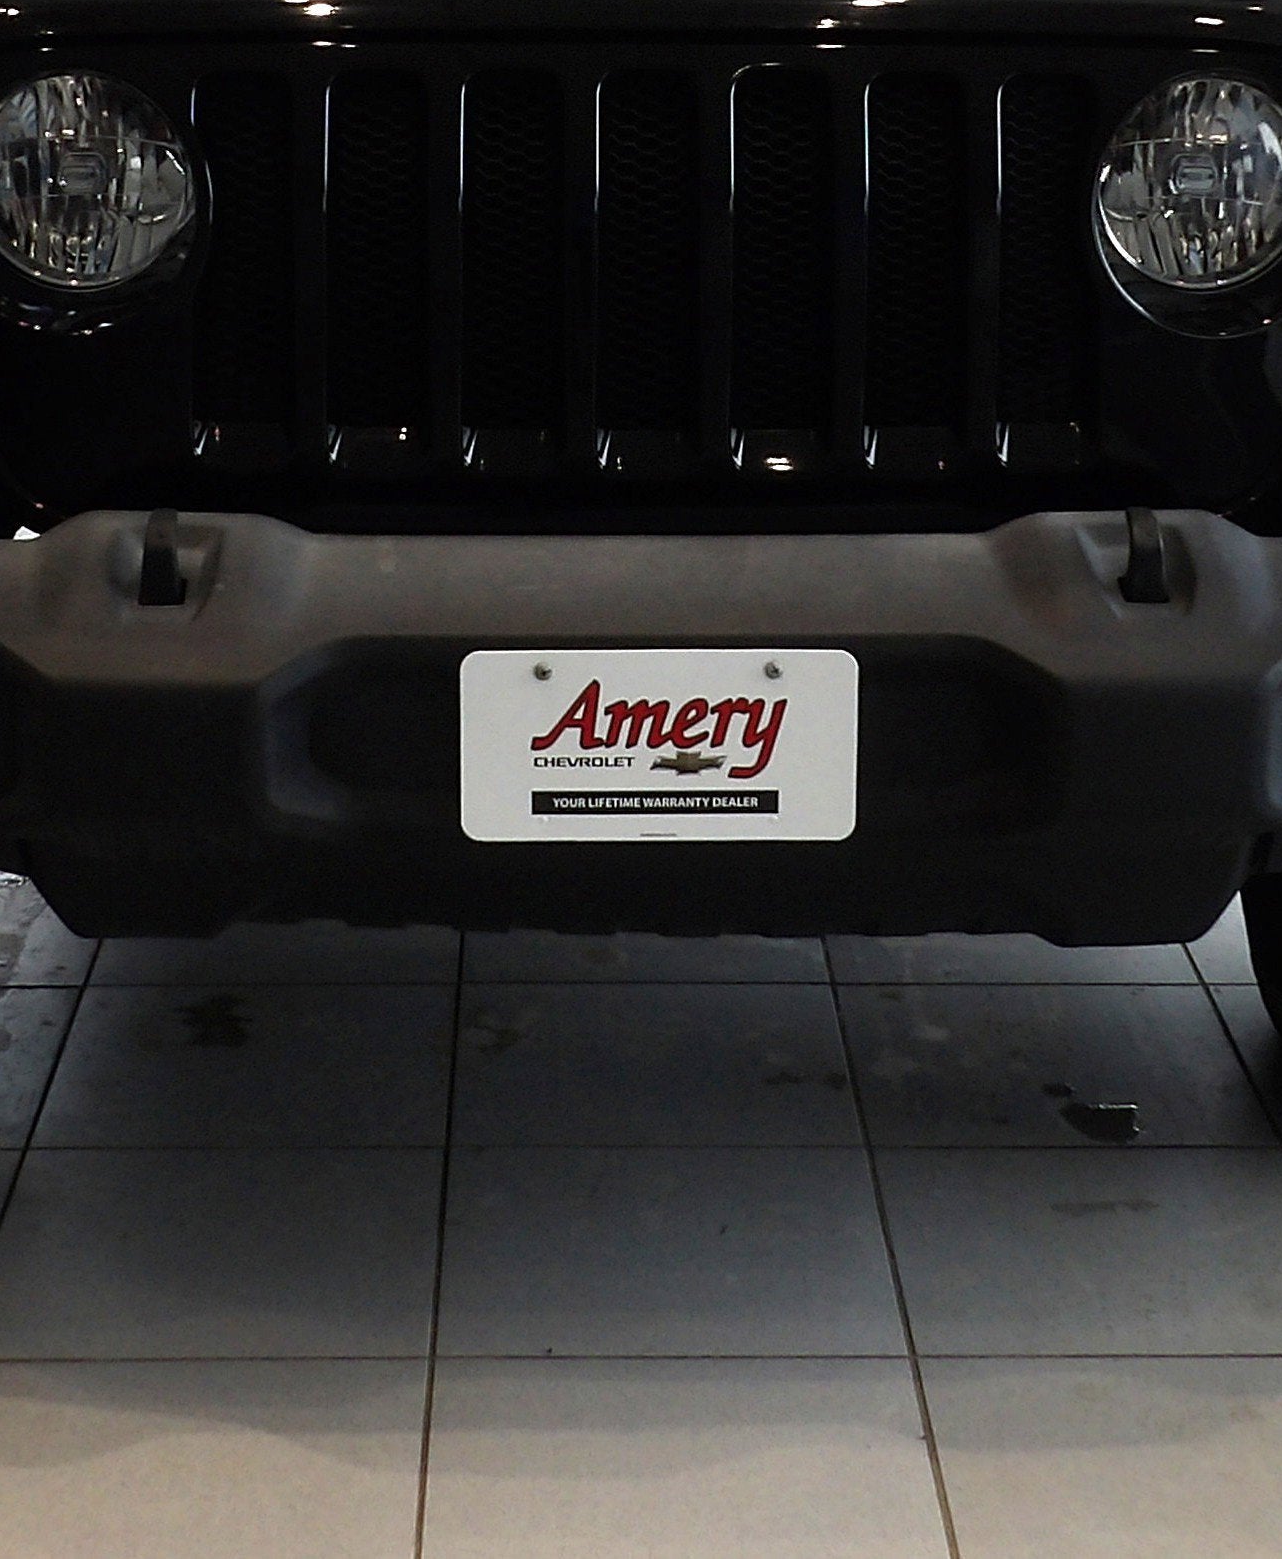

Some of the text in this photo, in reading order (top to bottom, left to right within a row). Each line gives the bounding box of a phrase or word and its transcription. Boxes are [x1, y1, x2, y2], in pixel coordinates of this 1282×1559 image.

[531, 678, 788, 779] Amery
[533, 756, 636, 768] CHEVROLET
[552, 796, 759, 809] YOUR LIFETIME WARRANTY DEALER
